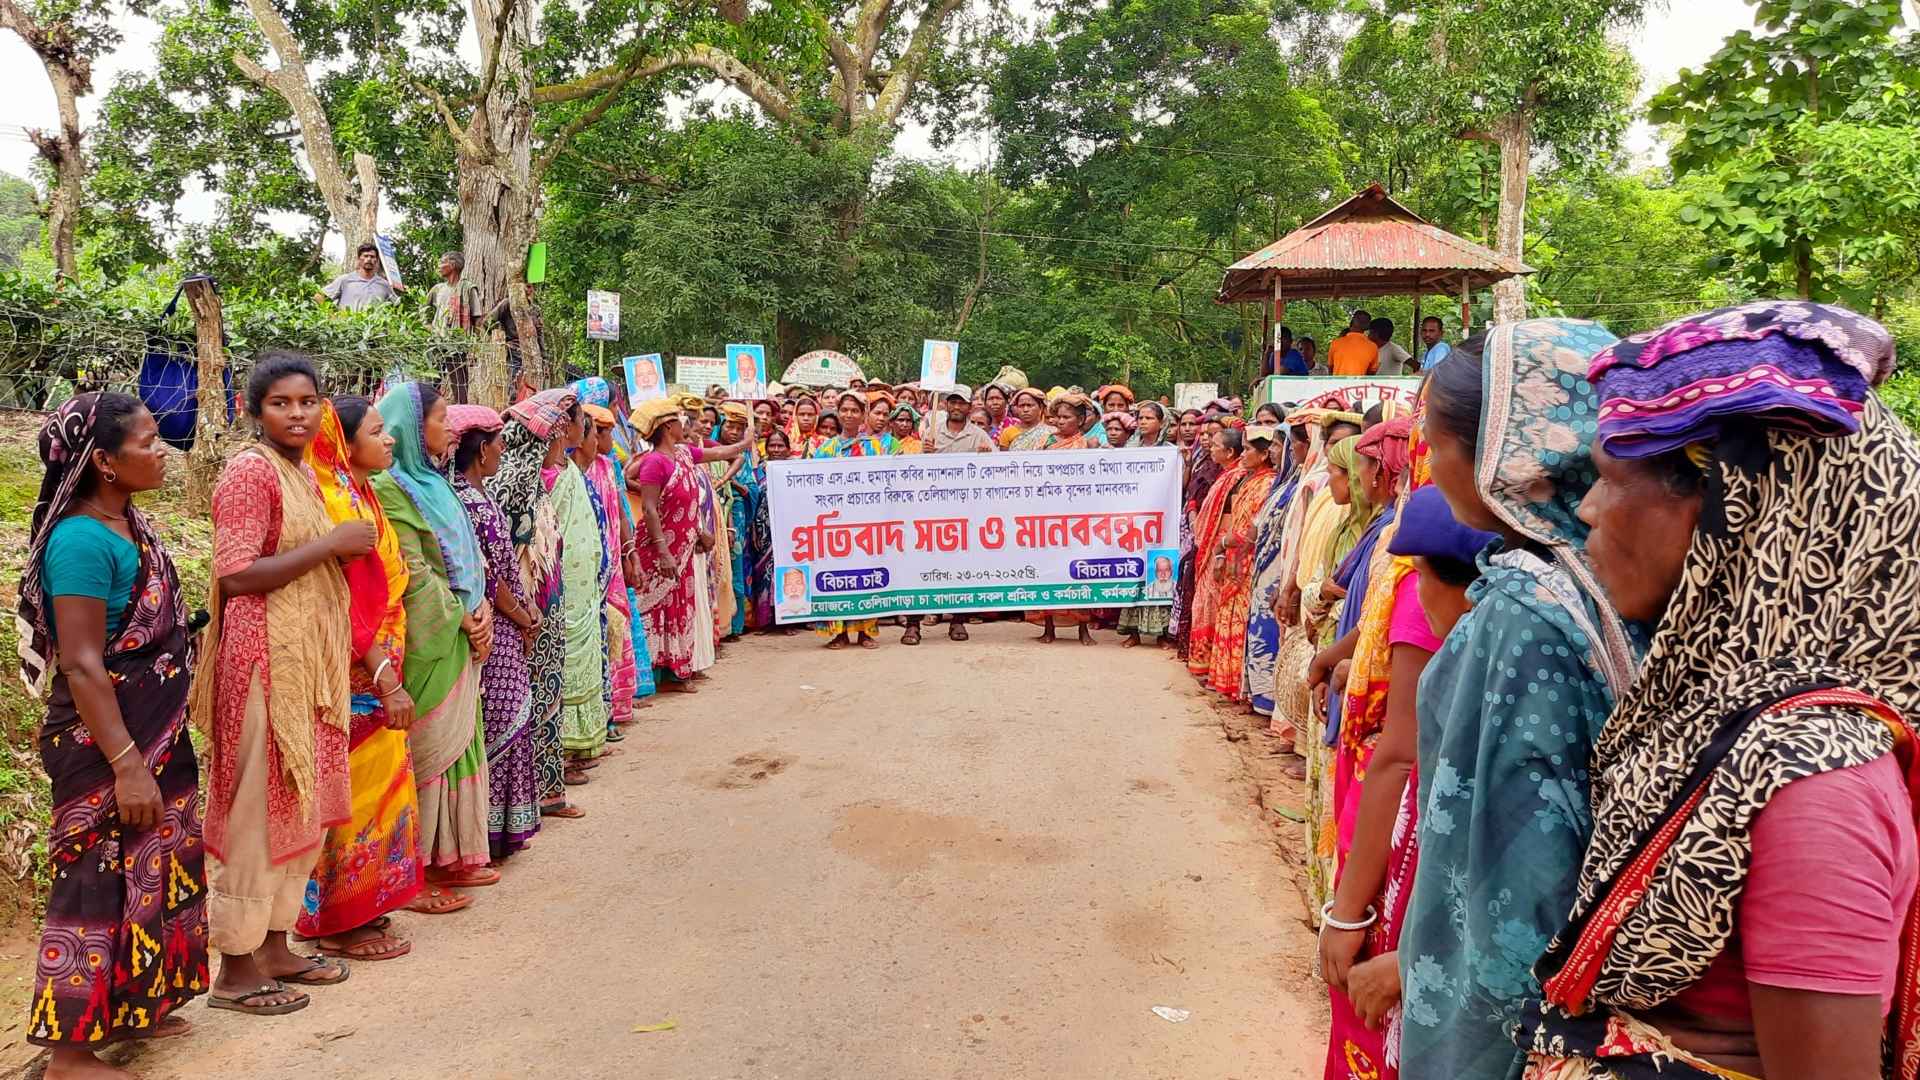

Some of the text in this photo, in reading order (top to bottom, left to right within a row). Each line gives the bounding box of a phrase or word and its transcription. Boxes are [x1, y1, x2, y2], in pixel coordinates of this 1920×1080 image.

[785, 470, 825, 488] চাঁদাবাজ
[900, 465, 924, 481] কবির
[927, 467, 964, 481] ন্যাশনাল
[967, 462, 977, 480] টি
[980, 461, 1019, 480] কোম্পানী
[1023, 461, 1042, 477] নিয়ে
[1046, 463, 1085, 476] অপপ্রচার
[1088, 463, 1096, 474] ও
[1099, 458, 1122, 475] মিথ্যা
[1125, 457, 1165, 474] বানোয়াট
[814, 493, 843, 509] সংবাদ
[847, 491, 881, 505] প্রচারের
[884, 486, 915, 504] বিরুদ্ধে
[918, 485, 969, 503] তেলিয়াপাড়া
[972, 488, 982, 500] চা
[985, 486, 1021, 499] বাগানের
[1024, 486, 1033, 498] চা
[1036, 481, 1063, 498] শ্রমিক
[1095, 483, 1139, 496] মানববন্ধন
[791, 510, 1165, 563] প্রতিবাদ সভা ও মানববন্ধন
[822, 569, 885, 590] বিচার চাই
[920, 569, 952, 581] তারিখ:
[1075, 559, 1139, 578] বিচার চাই
[812, 600, 855, 613] য়োজনে:
[858, 594, 915, 609] তেলিয়াপাড়া
[919, 594, 930, 605] চা
[932, 592, 974, 606] বাগানের
[977, 591, 1004, 603] সকল
[1007, 587, 1037, 602] শ্রমিক
[1041, 590, 1050, 600] ও
